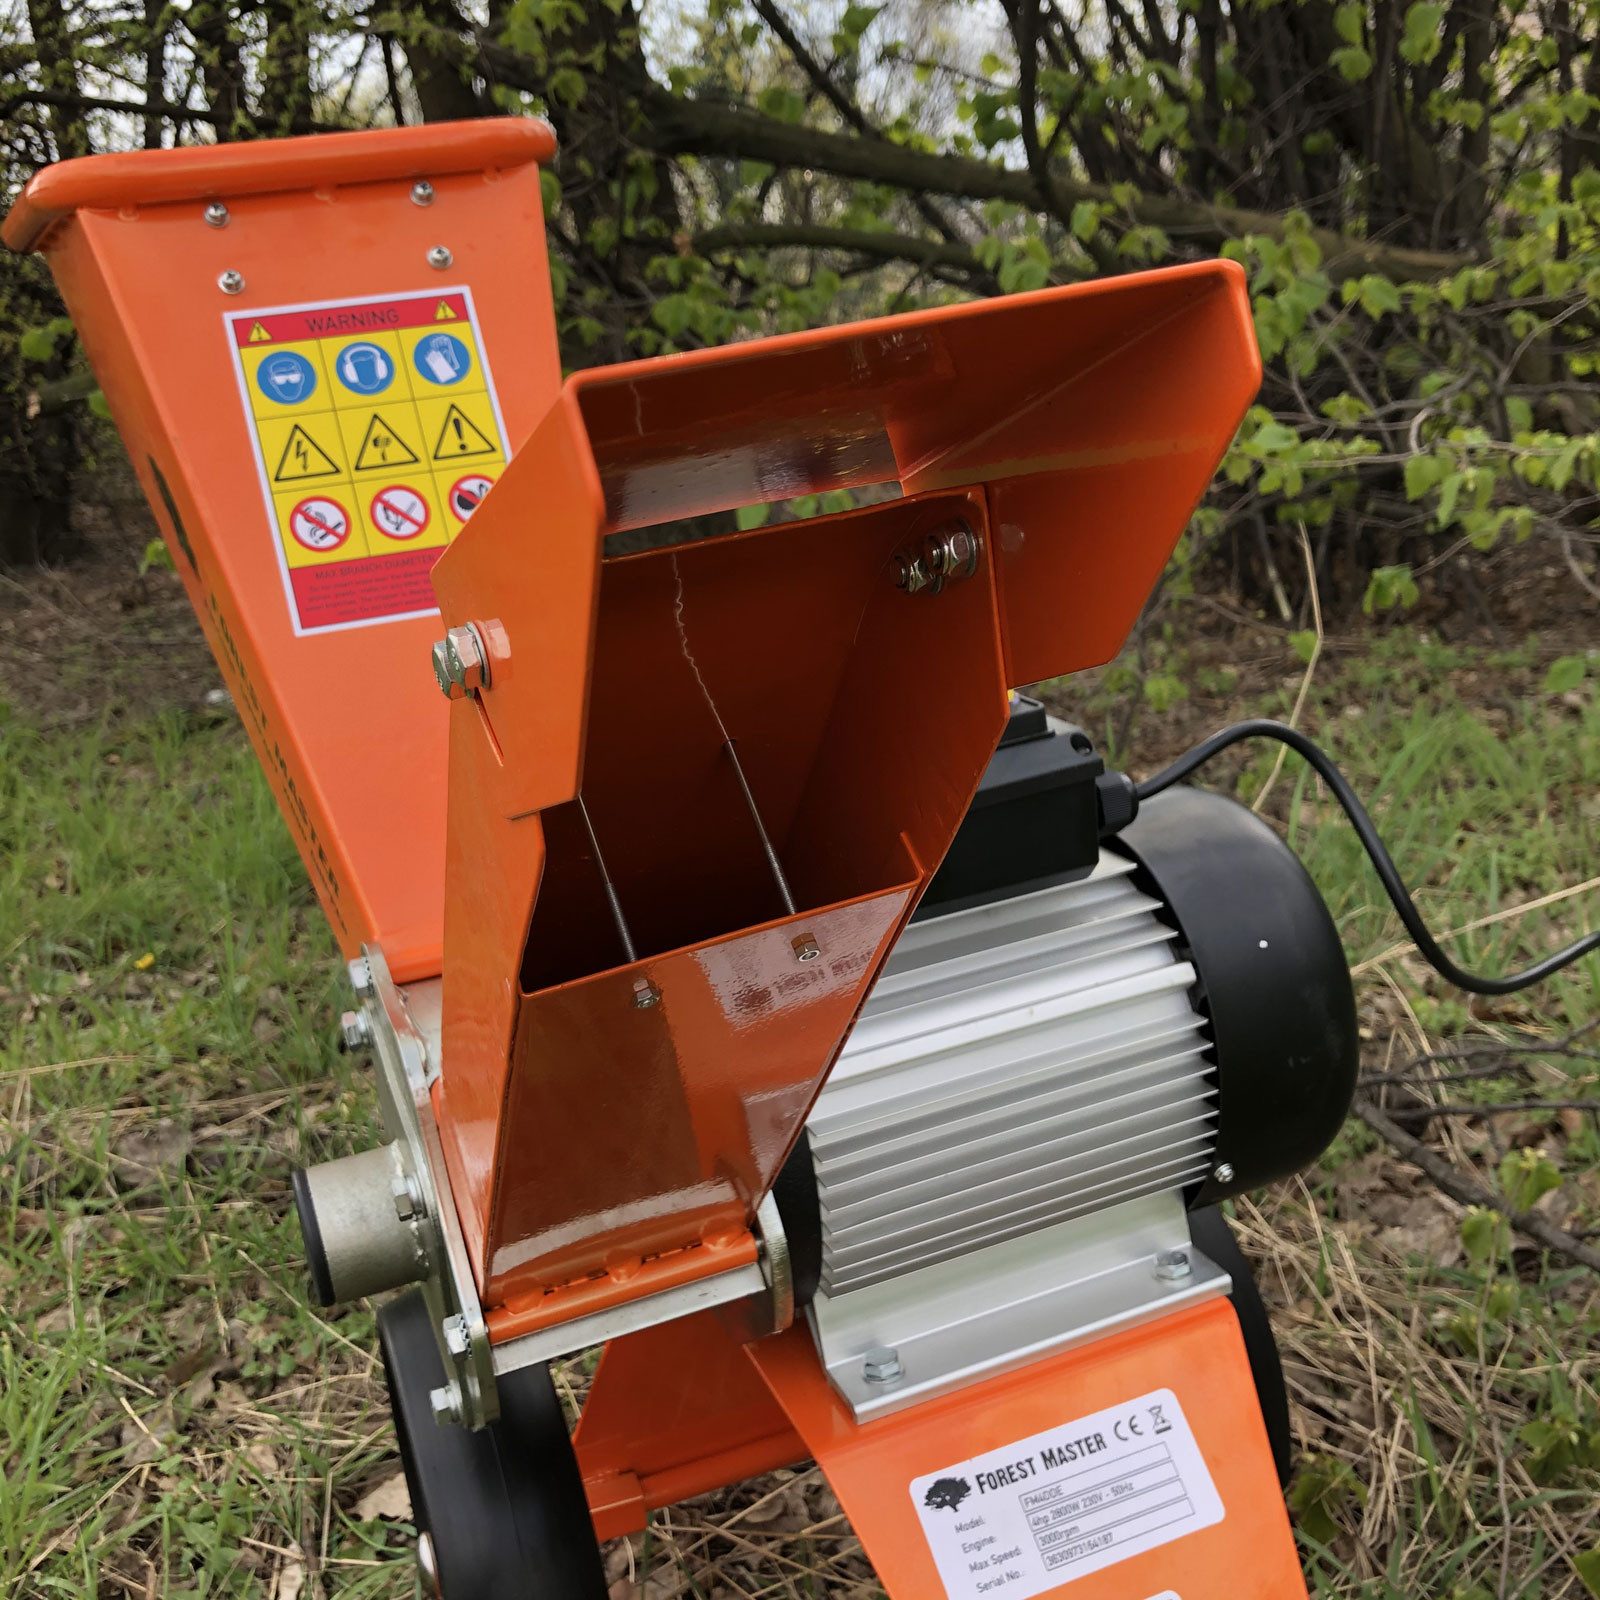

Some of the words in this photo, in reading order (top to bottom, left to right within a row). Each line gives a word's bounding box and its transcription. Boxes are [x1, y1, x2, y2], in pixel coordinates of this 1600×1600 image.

[304, 308, 400, 332] WARNING
[315, 570, 337, 579] MAX
[1113, 1415, 1144, 1441] CE
[975, 1457, 1037, 1494] FOREST
[1040, 1432, 1107, 1470] MASTER
[968, 1560, 990, 1573] Max
[975, 1574, 1006, 1593] Serial
